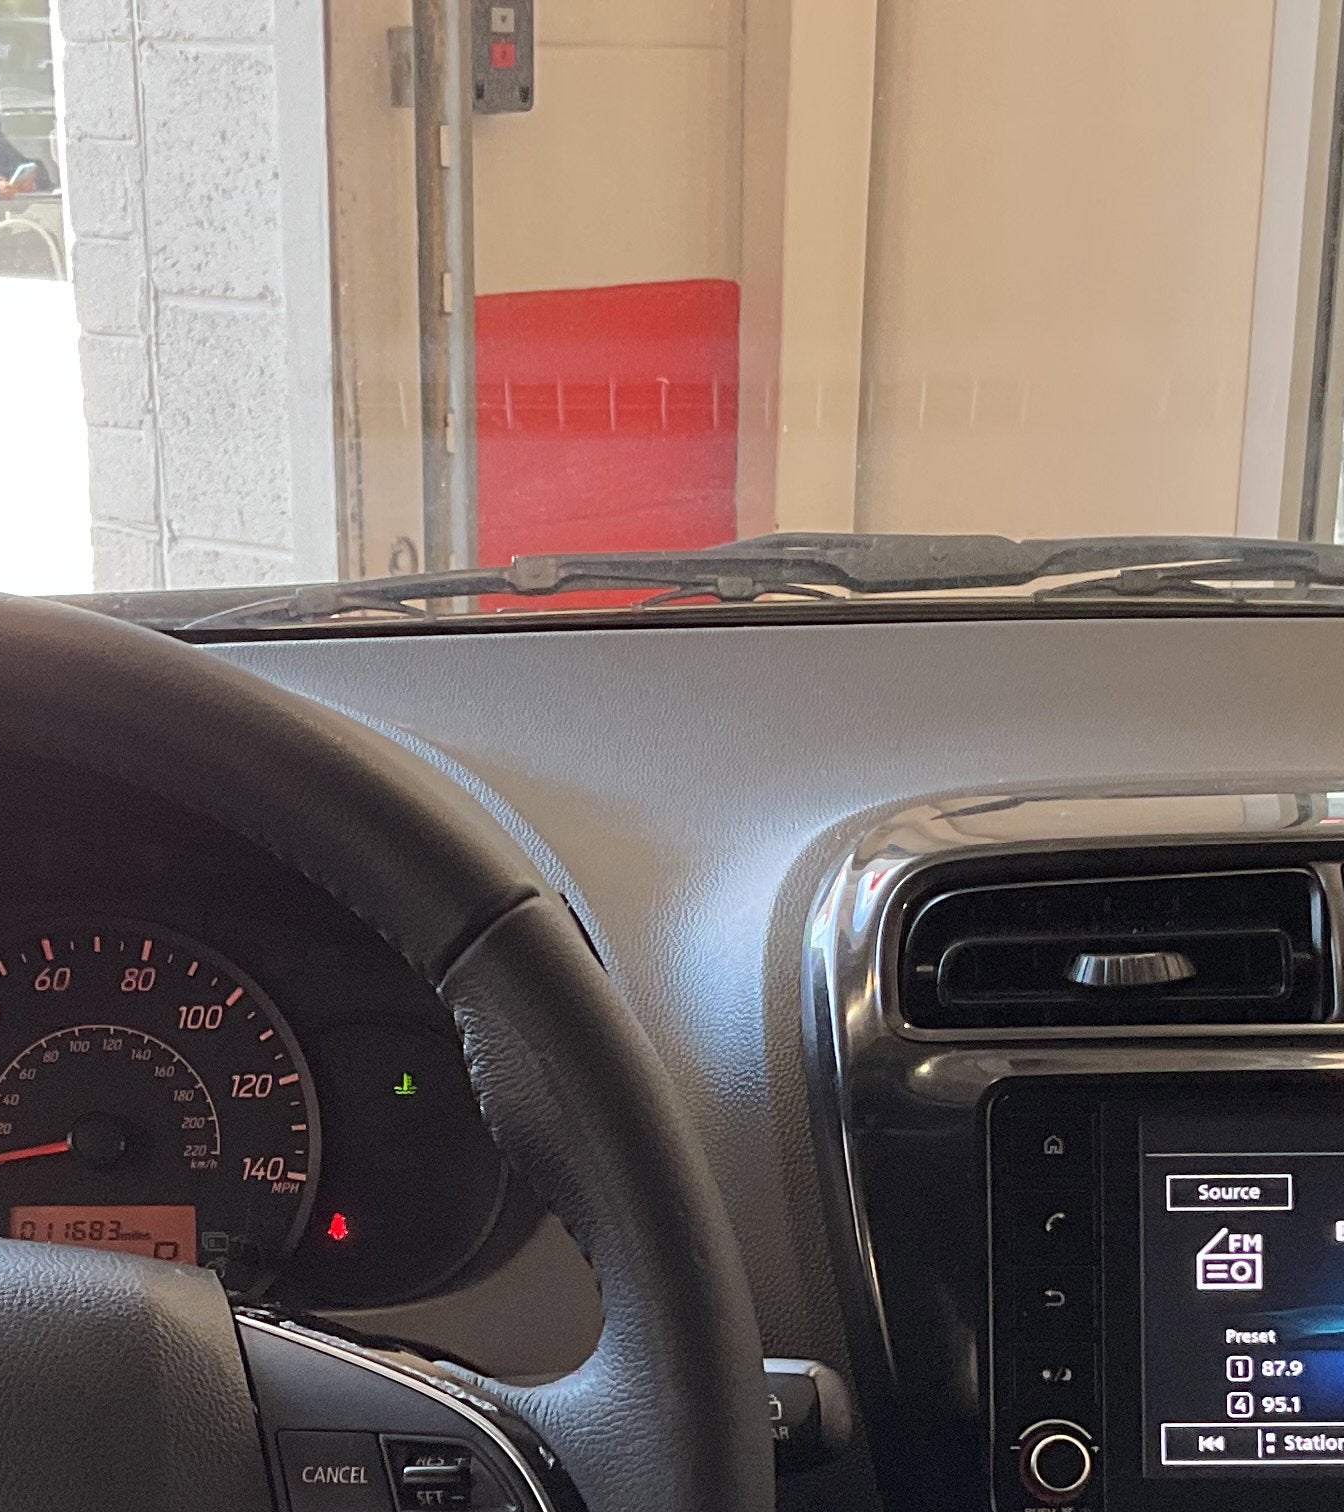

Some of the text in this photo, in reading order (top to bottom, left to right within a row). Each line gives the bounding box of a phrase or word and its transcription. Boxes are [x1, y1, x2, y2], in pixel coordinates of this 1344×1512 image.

[34, 967, 72, 991] 60
[120, 967, 156, 992] 80
[178, 1005, 223, 1030] 100
[69, 1040, 90, 1053] 100
[102, 1039, 123, 1051] 120
[42, 1051, 59, 1063] 80
[130, 1049, 151, 1061] 140
[19, 1068, 37, 1081] 60
[154, 1065, 175, 1078] 160
[230, 1073, 273, 1098] 120
[173, 1089, 194, 1101] 180
[181, 1116, 205, 1129] 200
[184, 1144, 207, 1157] 220
[242, 1156, 284, 1181] 140
[271, 1182, 301, 1194] MPH
[1197, 1184, 1261, 1201] Source
[1228, 1233, 1263, 1253] FM
[1225, 1328, 1277, 1345] Preset
[1261, 1360, 1304, 1377] 87.9
[1261, 1397, 1302, 1413] 95.1
[302, 1465, 368, 1484] CANCEL
